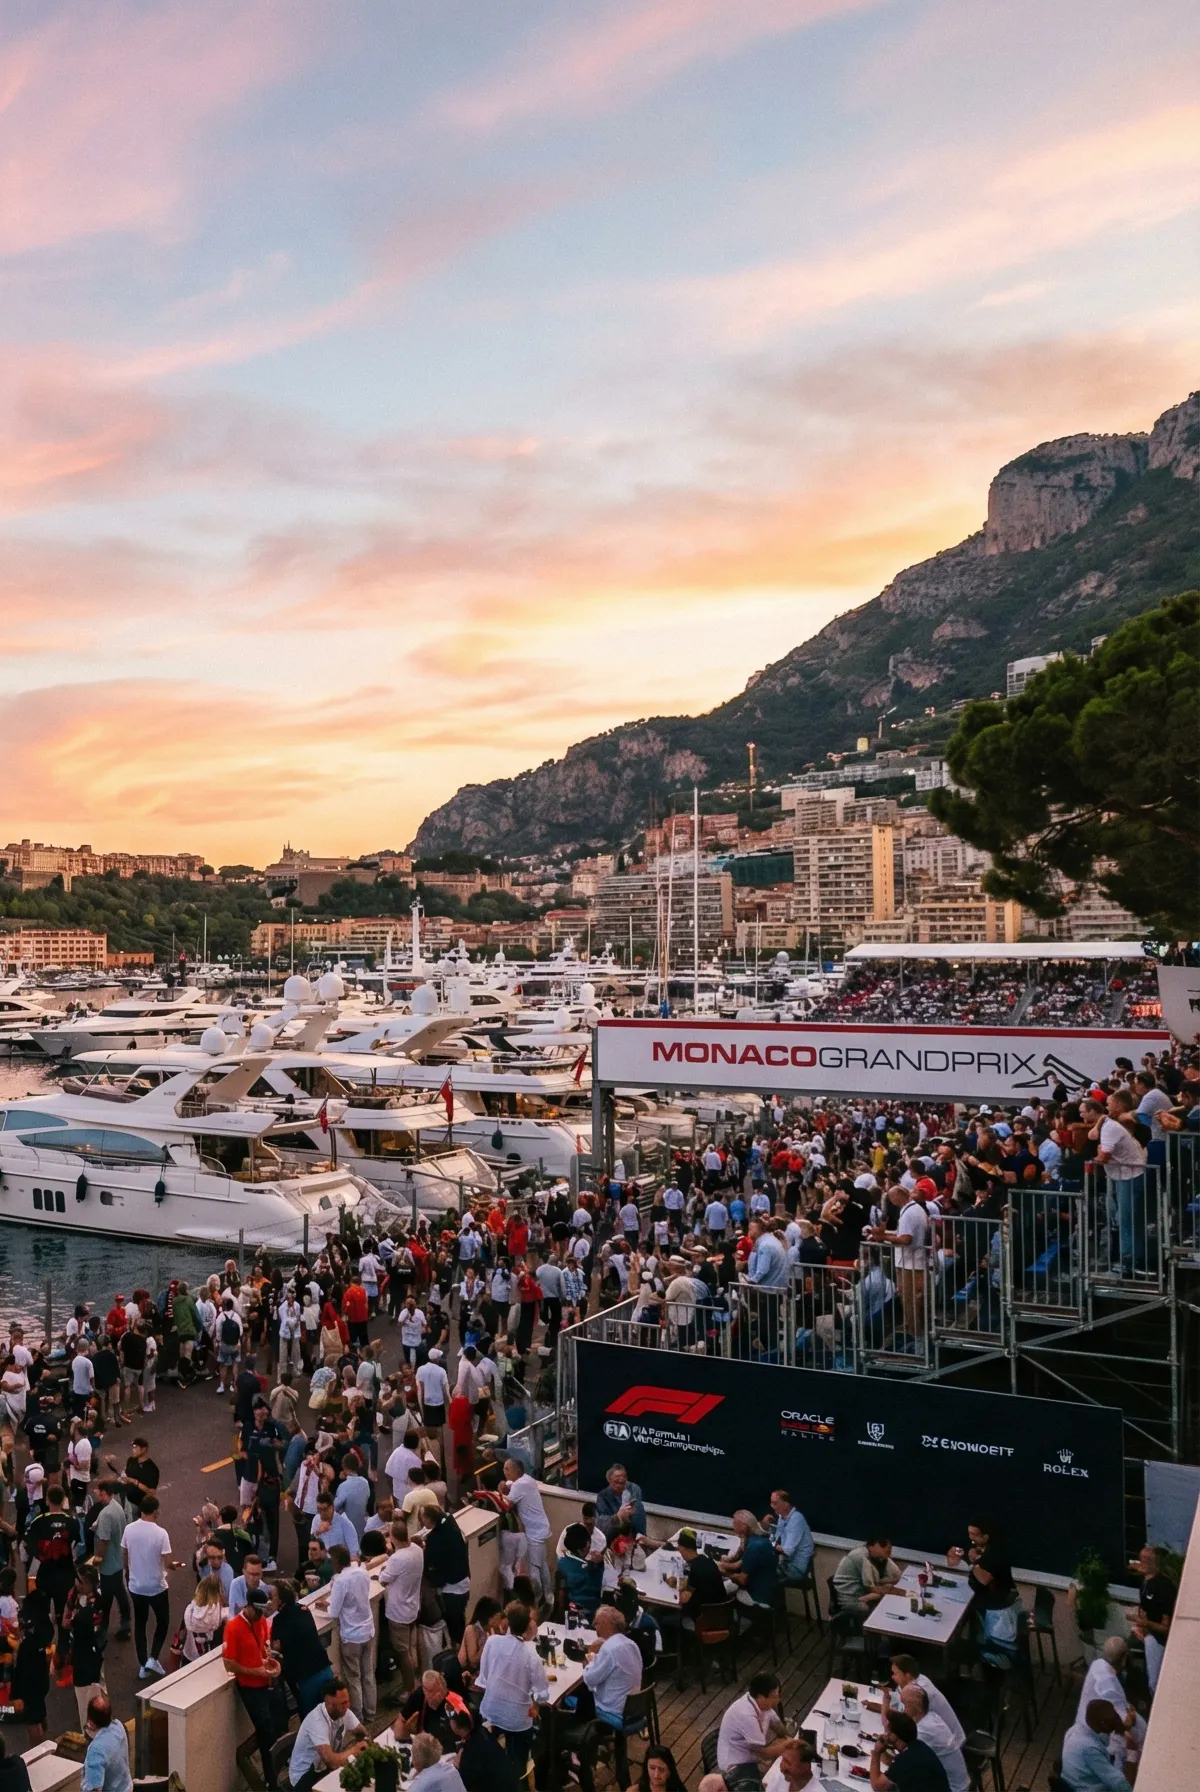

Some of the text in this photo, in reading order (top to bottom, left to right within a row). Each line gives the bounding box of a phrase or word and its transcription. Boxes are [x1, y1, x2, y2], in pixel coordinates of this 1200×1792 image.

[781, 1410, 835, 1425] ORACLE
[605, 1422, 629, 1439] FIA
[1042, 1463, 1089, 1478] ROLEX
